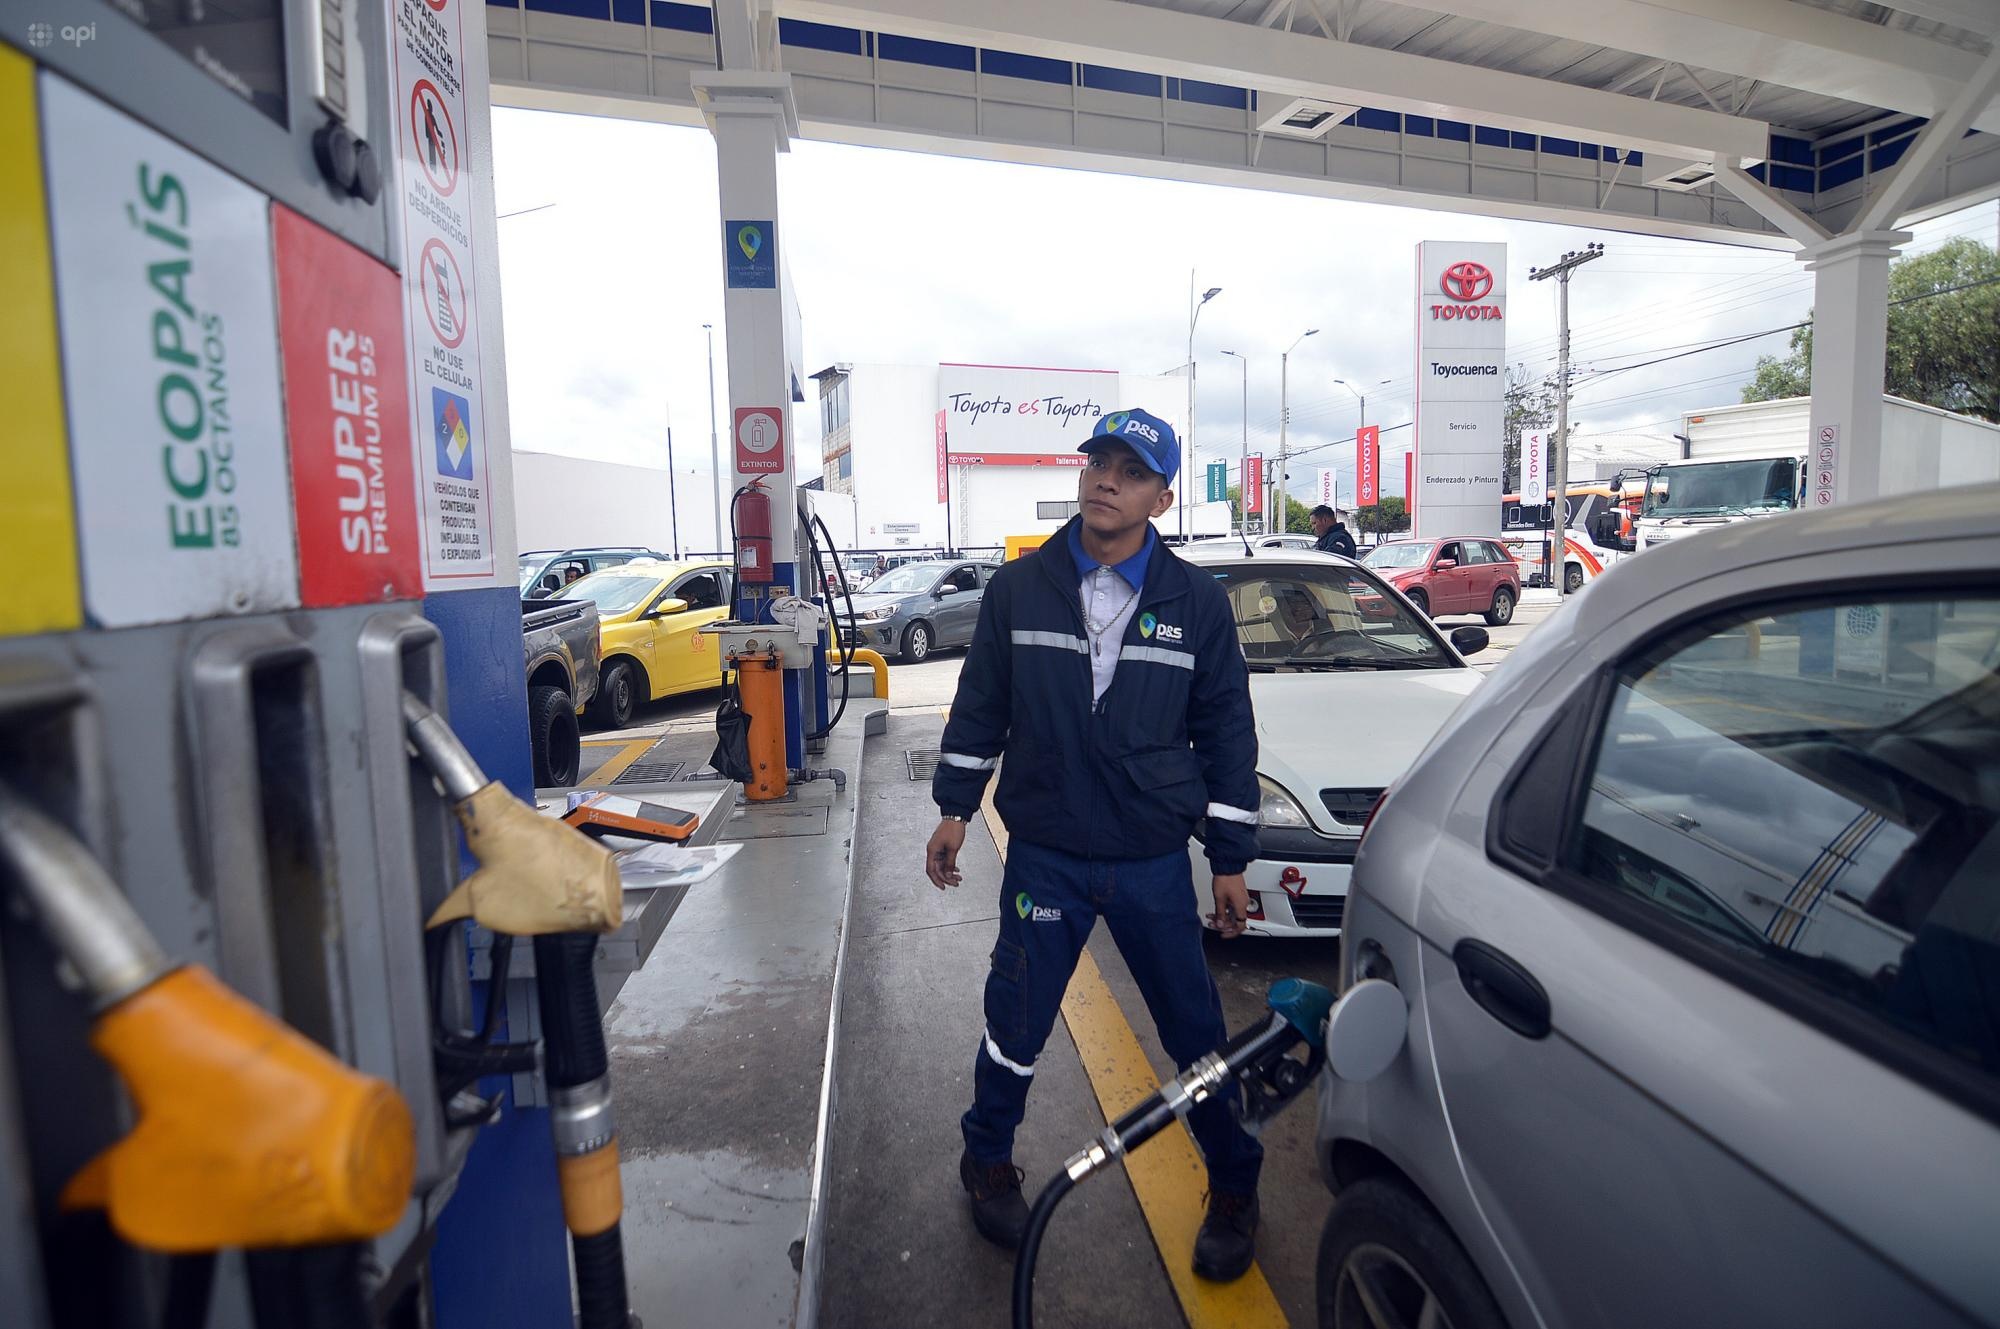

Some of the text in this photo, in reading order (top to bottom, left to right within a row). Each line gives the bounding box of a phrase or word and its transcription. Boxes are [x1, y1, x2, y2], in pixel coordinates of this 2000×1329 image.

[397, 14, 413, 39] PARA
[403, 2, 454, 71] EL MOTOR
[406, 38, 456, 98] DE COMBUSTIBLE
[414, 178, 462, 228] NO ARROJE
[408, 191, 469, 248] DESPERDICIOS
[1430, 304, 1503, 321] TOYOTA
[125, 161, 217, 551] ECOPAÍS
[433, 345, 464, 372] NO USE
[1431, 362, 1498, 379] Toyocuenca
[424, 358, 474, 391] EL CELULAR
[949, 392, 1012, 426] Toyota
[1018, 399, 1040, 415] es
[202, 312, 241, 549] 85 OCTANOS
[327, 327, 373, 555] SUPER
[442, 423, 448, 435] 2
[1448, 422, 1477, 430] Servicio
[358, 335, 390, 554] PREMIUM 95
[1363, 431, 1371, 481] TOYOTA
[1530, 435, 1538, 480] TOYOTA
[433, 481, 480, 500] VEHÍCULOS QUE
[1323, 471, 1331, 502] TOYOTA
[1425, 475, 1499, 485] Enderezado y Pintura
[440, 499, 476, 514] CONTENGAN
[441, 515, 476, 529] PRODUCTOS
[440, 532, 480, 545] INFLAMABLES
[441, 548, 482, 560] O EXPLOSIVOS
